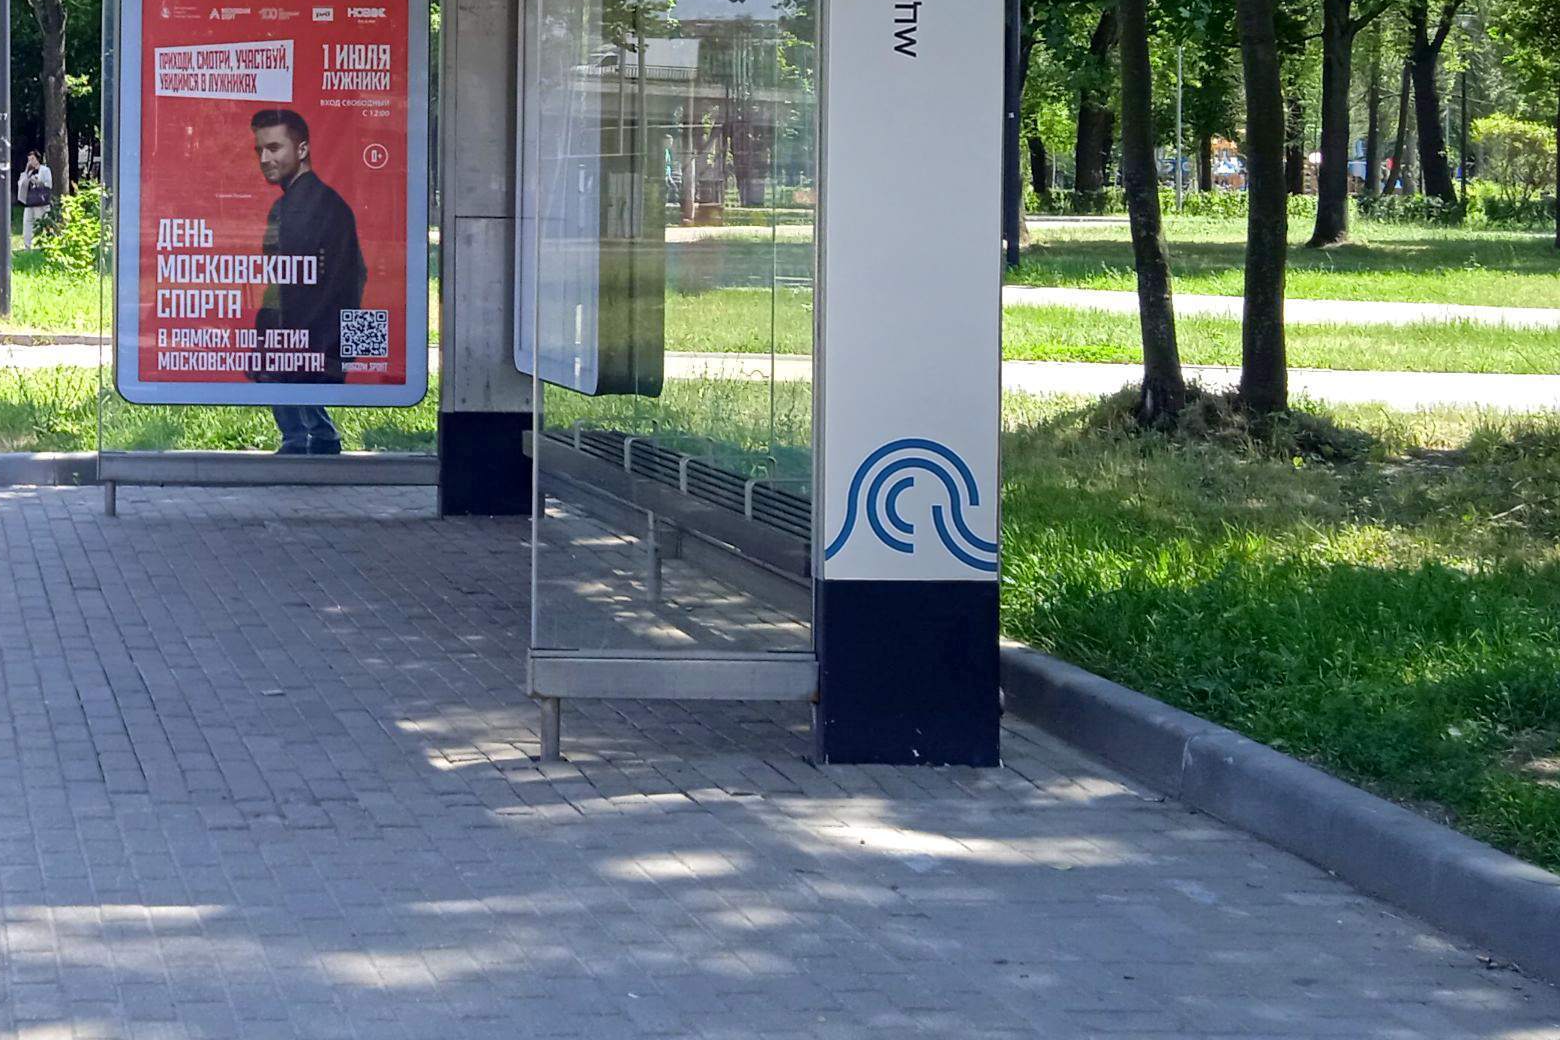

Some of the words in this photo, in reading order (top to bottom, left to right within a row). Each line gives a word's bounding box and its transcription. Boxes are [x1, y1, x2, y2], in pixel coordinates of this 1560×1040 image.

[159, 51, 195, 71] ПРИХОДИ,
[197, 50, 233, 71] СМОТРИ,
[236, 44, 289, 71] УЧАСТВУЙ,
[322, 44, 329, 69] 1
[335, 44, 390, 69] ИЮЛЯ
[159, 73, 199, 93] УВИДИМСЯ
[201, 73, 207, 92] В
[208, 73, 257, 94] ЛУЖНИКАХ
[321, 71, 390, 90] ЛУЖНИКИ
[320, 99, 341, 107] ВХОД
[342, 99, 390, 107] СВОБОДНЫЙ
[157, 218, 214, 251] ДЕНЬ
[157, 255, 317, 285] МОСКОВСКОГО
[157, 289, 242, 318] СПОРТА
[158, 328, 167, 348] В
[172, 328, 231, 348] РАМКАХ
[235, 329, 310, 349] 100-ЛЕТИЯ
[158, 351, 262, 371] МОСКОВСКОГО
[266, 352, 325, 372] СПОРТА!
